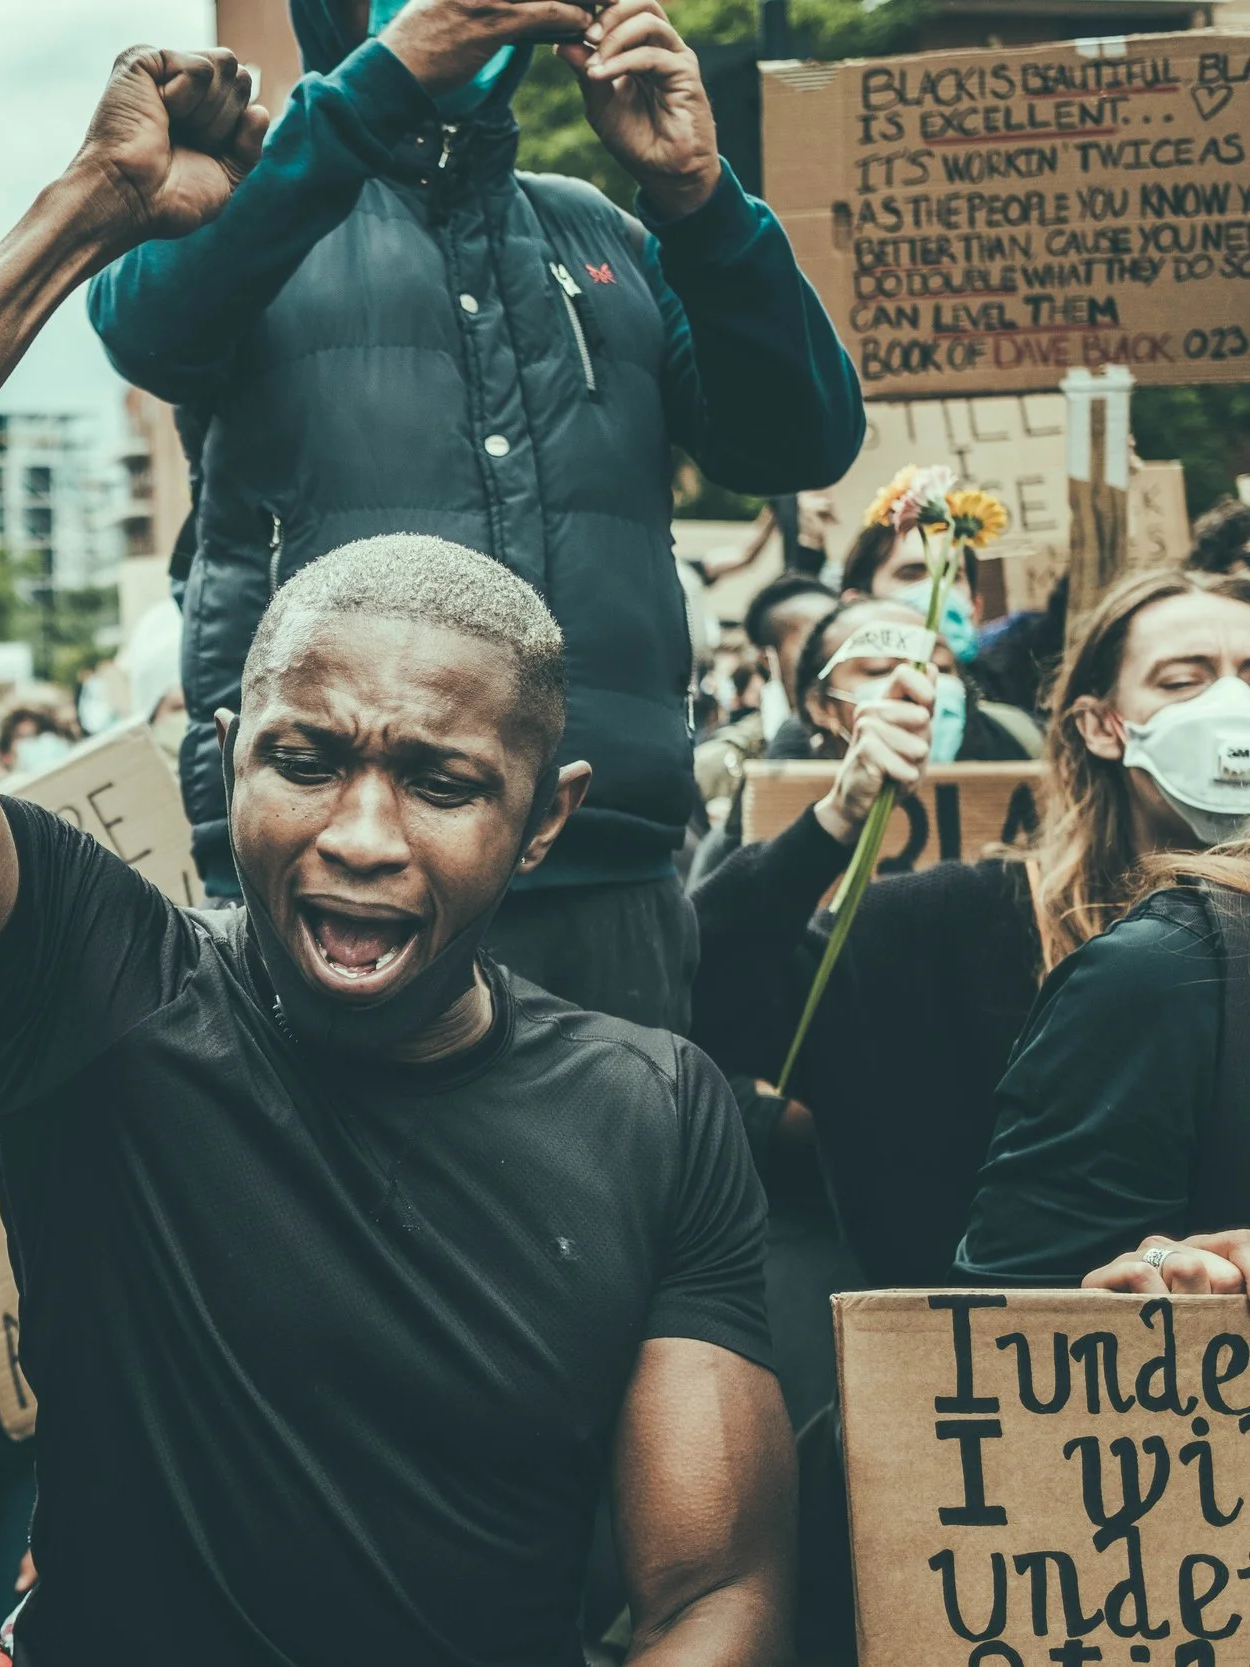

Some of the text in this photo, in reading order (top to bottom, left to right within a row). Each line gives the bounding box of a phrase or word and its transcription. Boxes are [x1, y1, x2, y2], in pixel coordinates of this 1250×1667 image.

[862, 66, 977, 112] BLACK
[979, 63, 1016, 100] IS
[1021, 57, 1181, 96] BEAUTIFUL
[856, 110, 905, 146] IS
[1074, 138, 1196, 173] TWICE
[1199, 132, 1246, 165] AS
[856, 196, 904, 234] AS
[904, 192, 963, 229] THE
[965, 190, 1070, 229] PEOPLE
[1076, 186, 1129, 222] YOU
[1140, 181, 1231, 219] KNOW
[853, 234, 958, 272] BETTER
[956, 230, 1032, 263] THAN
[1139, 222, 1197, 254] YOU
[853, 269, 903, 300] DO
[907, 264, 1018, 297] DOUBLE
[1020, 258, 1099, 289] WHAT
[1100, 255, 1166, 287] THEY
[1173, 253, 1215, 283] DO
[850, 292, 1120, 334] CAN LEVEL THEM
[860, 335, 943, 381] BOOK
[946, 338, 988, 372] OF
[993, 333, 1069, 371] DAVE
[1081, 331, 1175, 367] BLACK
[928, 1294, 1007, 1414] I
[935, 1416, 1250, 1527] I wi
[928, 1525, 1250, 1642] unde
